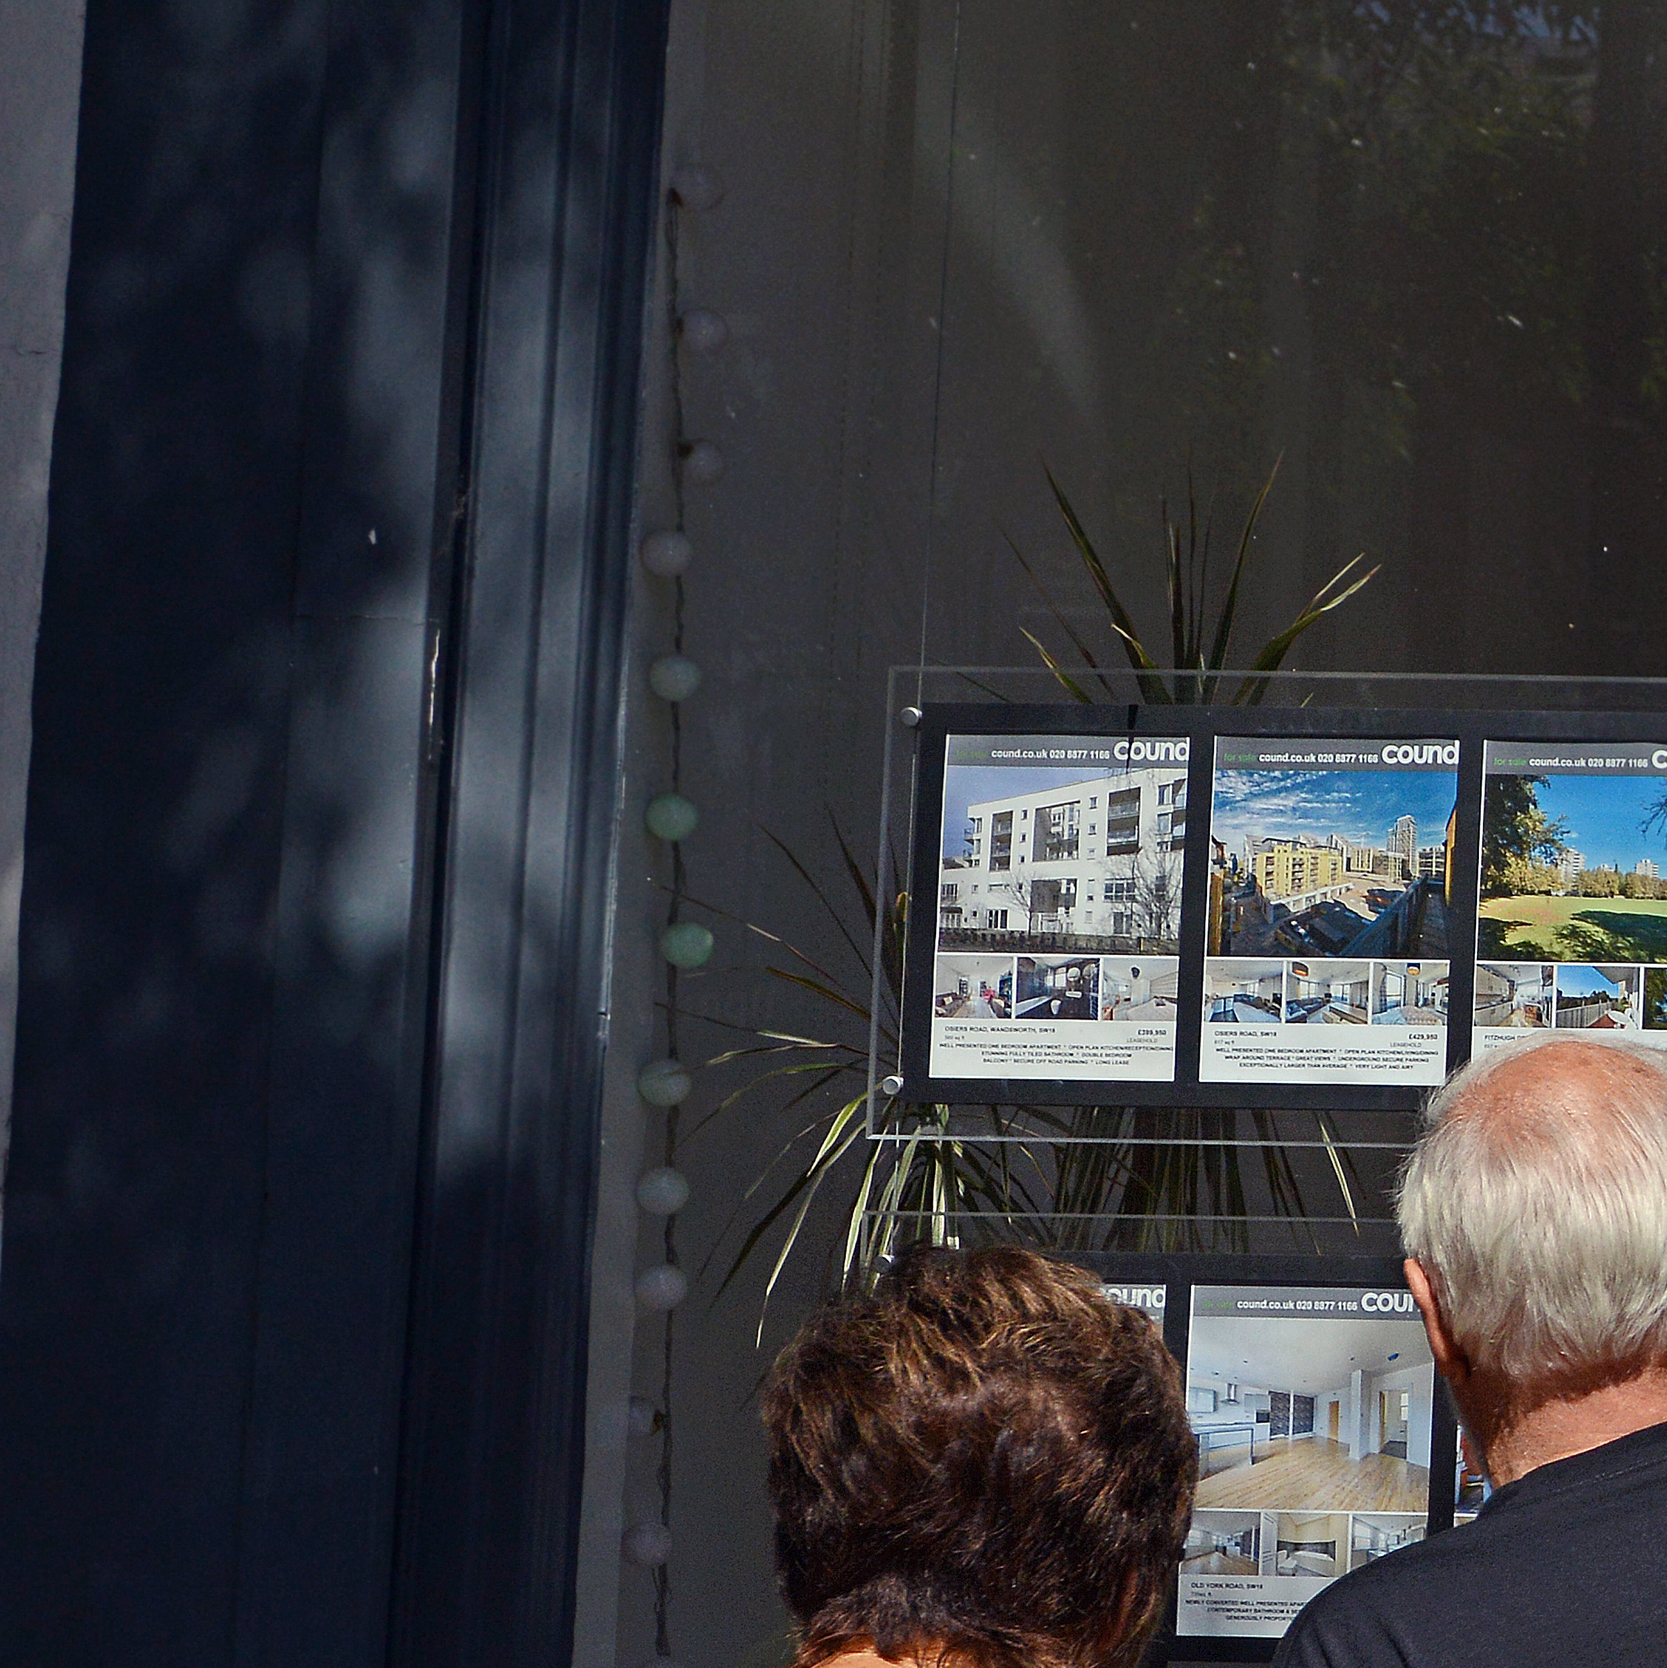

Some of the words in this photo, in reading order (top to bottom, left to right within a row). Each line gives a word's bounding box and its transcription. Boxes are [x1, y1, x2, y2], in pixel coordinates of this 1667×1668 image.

[992, 749, 1048, 759] cound.co.uk
[1050, 751, 1064, 759] 020
[1065, 751, 1088, 759] 8877
[1090, 751, 1110, 760] 1166
[1114, 737, 1190, 761] cound
[1381, 740, 1459, 765] cound
[1259, 752, 1316, 763] cound.co.uk
[1318, 754, 1334, 763] 020
[1336, 755, 1357, 763] 8877
[1359, 755, 1378, 763] 1166
[1529, 757, 1586, 767] cound.co.uk
[1588, 759, 1604, 767] 020
[1606, 759, 1626, 768] 8877
[1629, 759, 1648, 768] 1166
[1101, 1288, 1166, 1309] ound
[1237, 1300, 1294, 1310] cound.co.uk
[1296, 1301, 1312, 1310] 020
[1314, 1302, 1334, 1310] 8877
[1338, 1302, 1357, 1311] 1166
